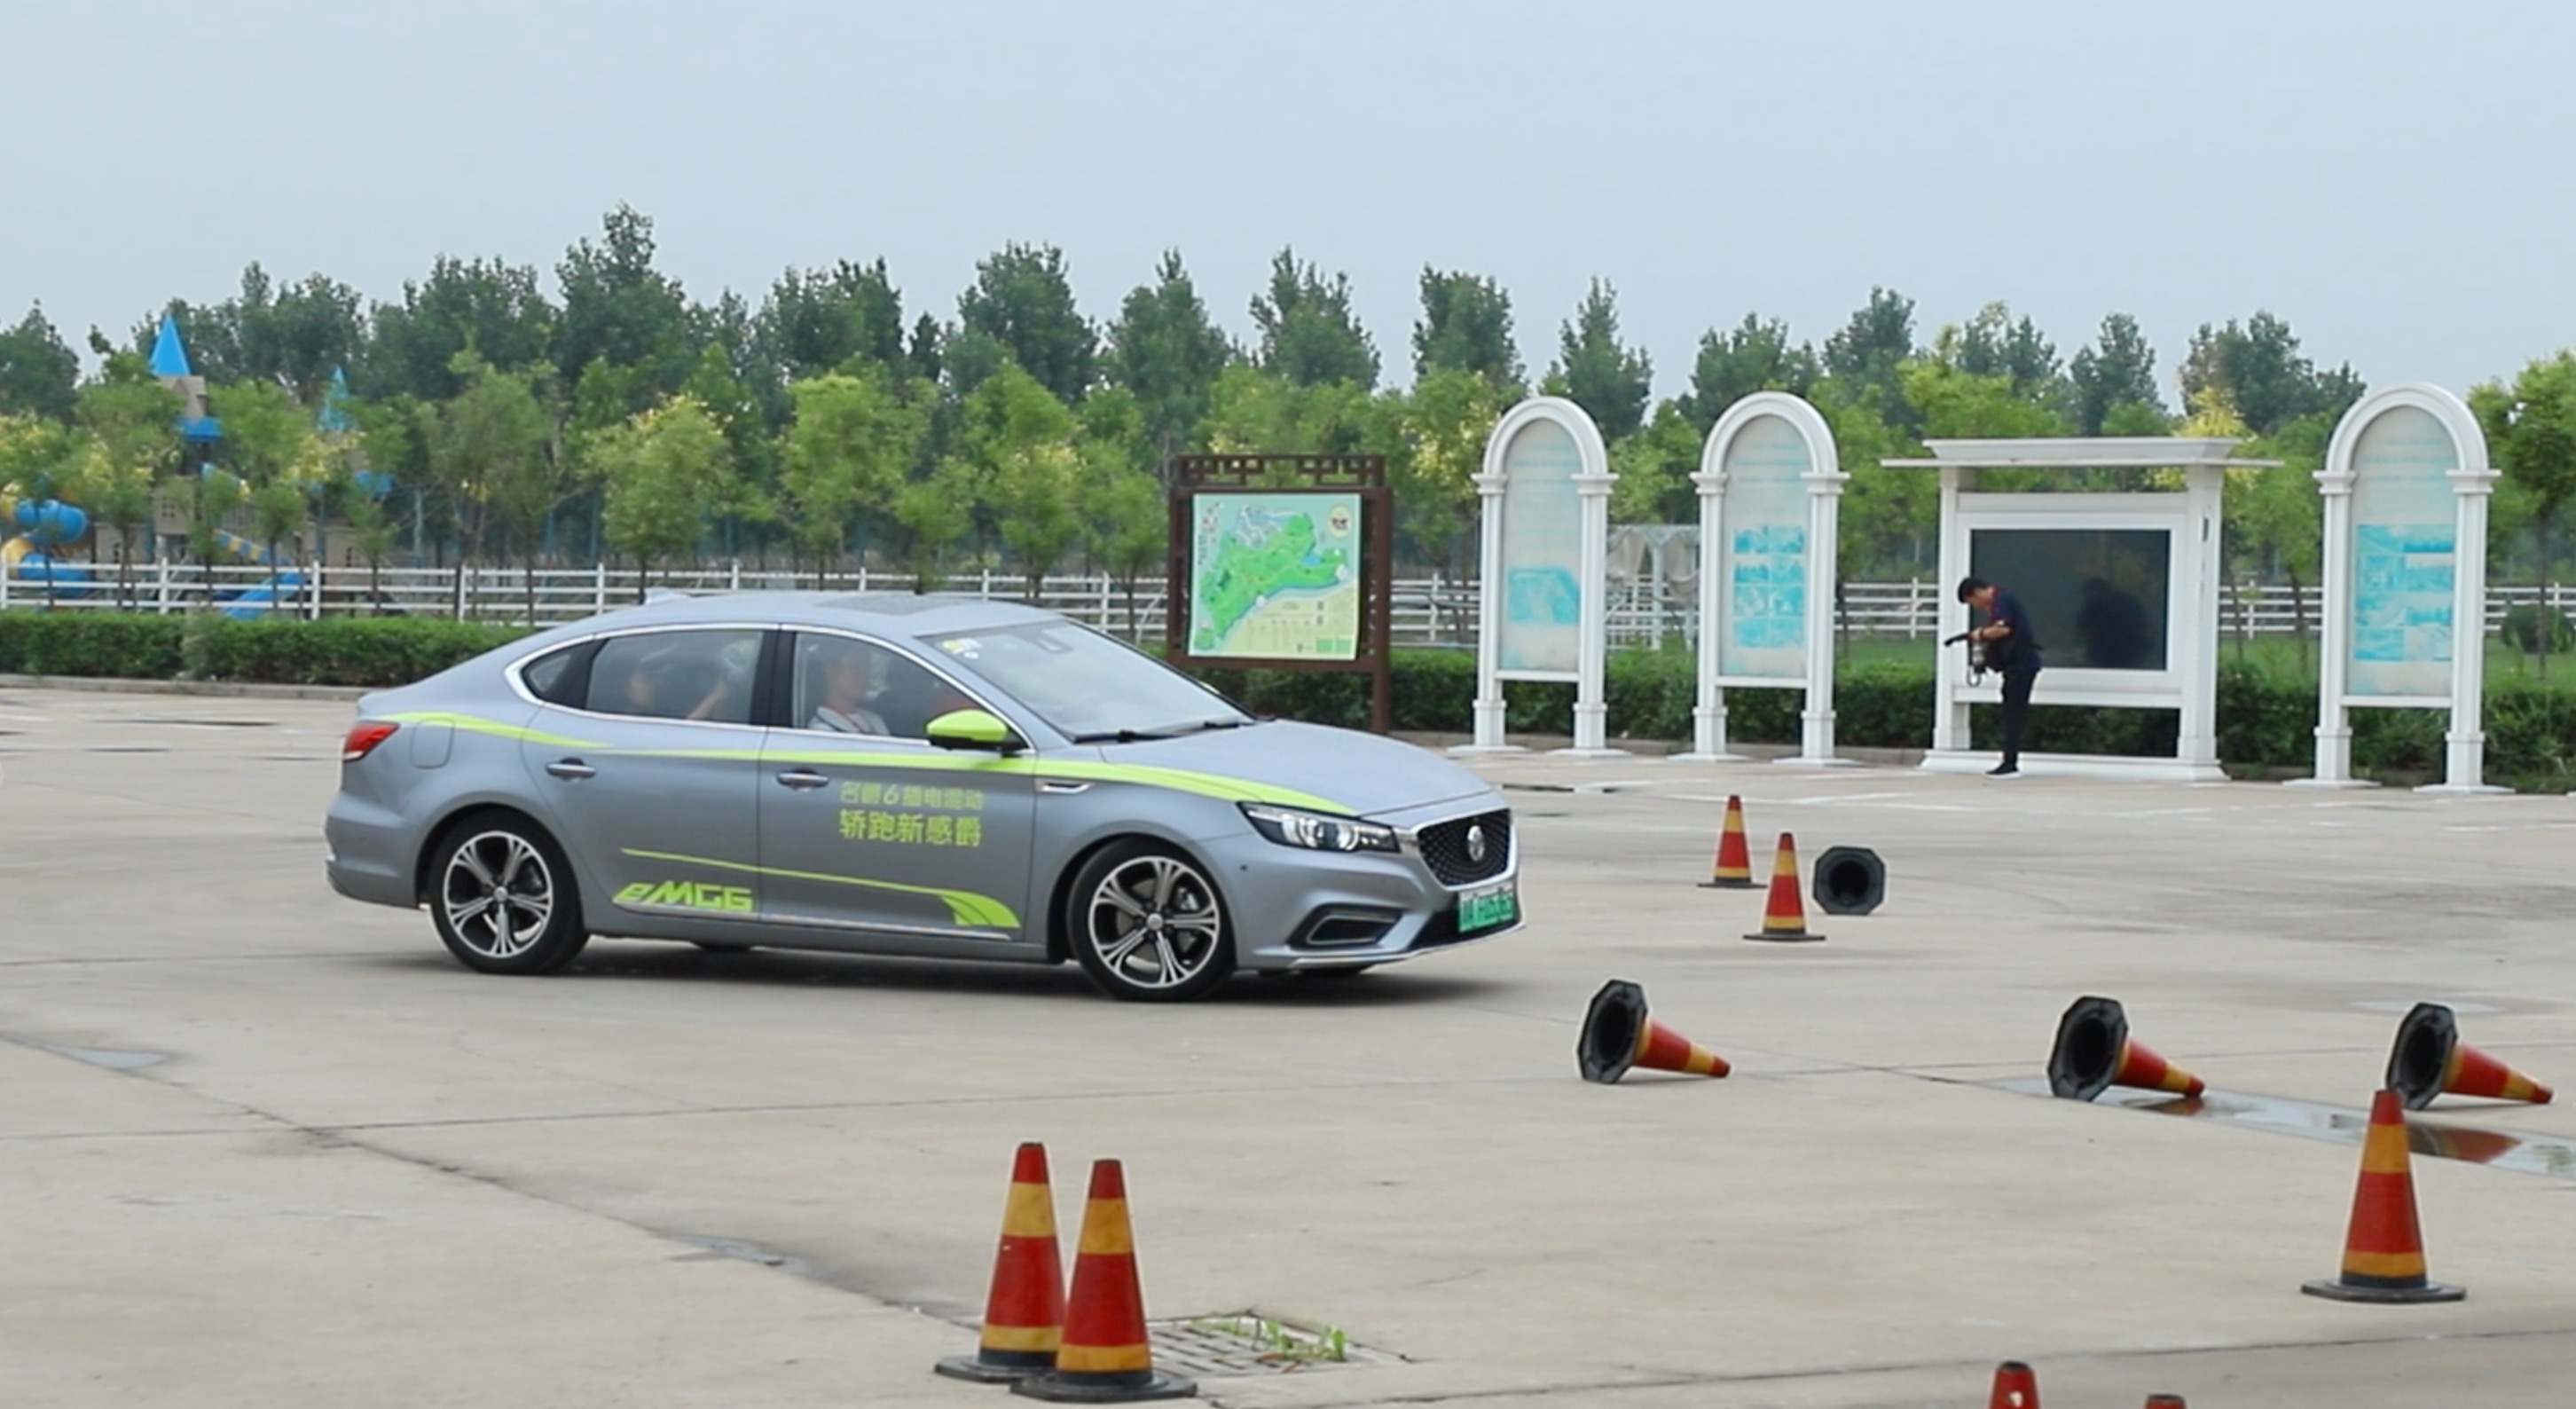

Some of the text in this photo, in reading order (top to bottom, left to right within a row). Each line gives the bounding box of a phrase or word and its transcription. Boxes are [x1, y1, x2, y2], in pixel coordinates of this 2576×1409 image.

[839, 808, 981, 846] 轿跑新感爵
